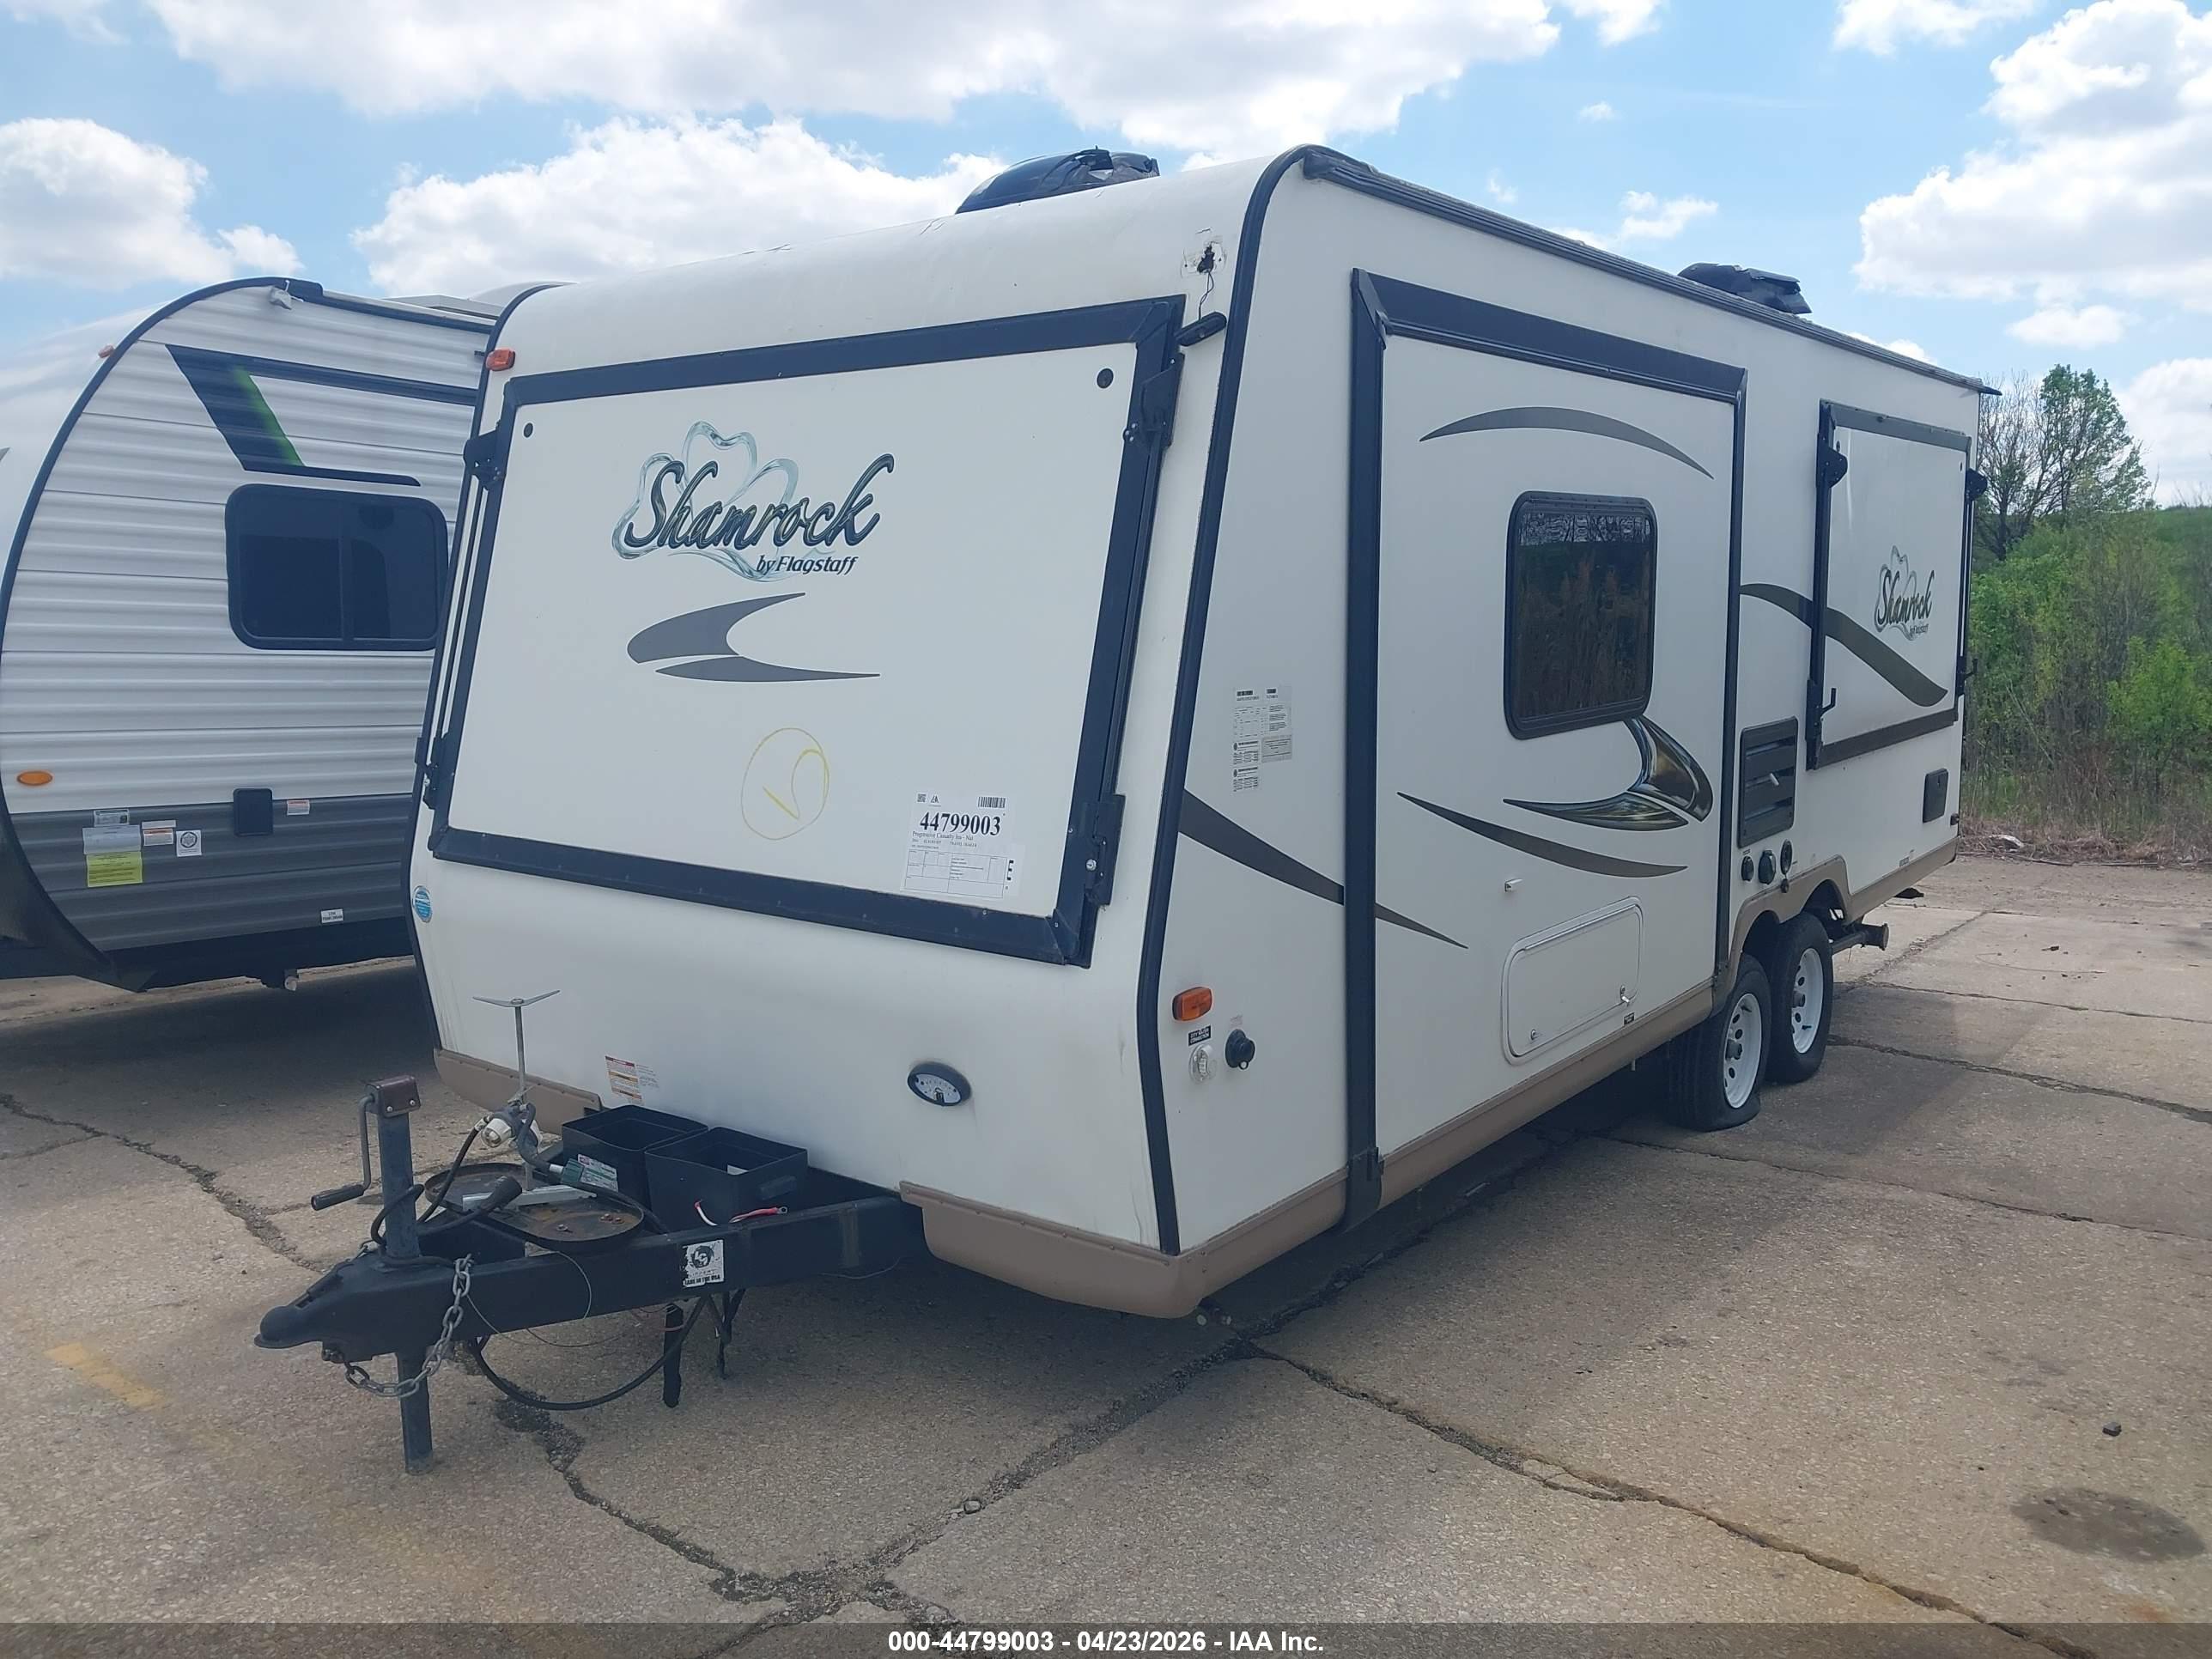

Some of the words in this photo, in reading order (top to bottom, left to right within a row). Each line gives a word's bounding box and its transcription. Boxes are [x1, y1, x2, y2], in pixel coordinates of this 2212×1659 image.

[624, 453, 895, 550] Shamrock
[756, 555, 775, 575] by
[775, 556, 860, 575] Flagstaff
[1877, 568, 1936, 625] Shamrock
[920, 811, 1001, 836] 44799003
